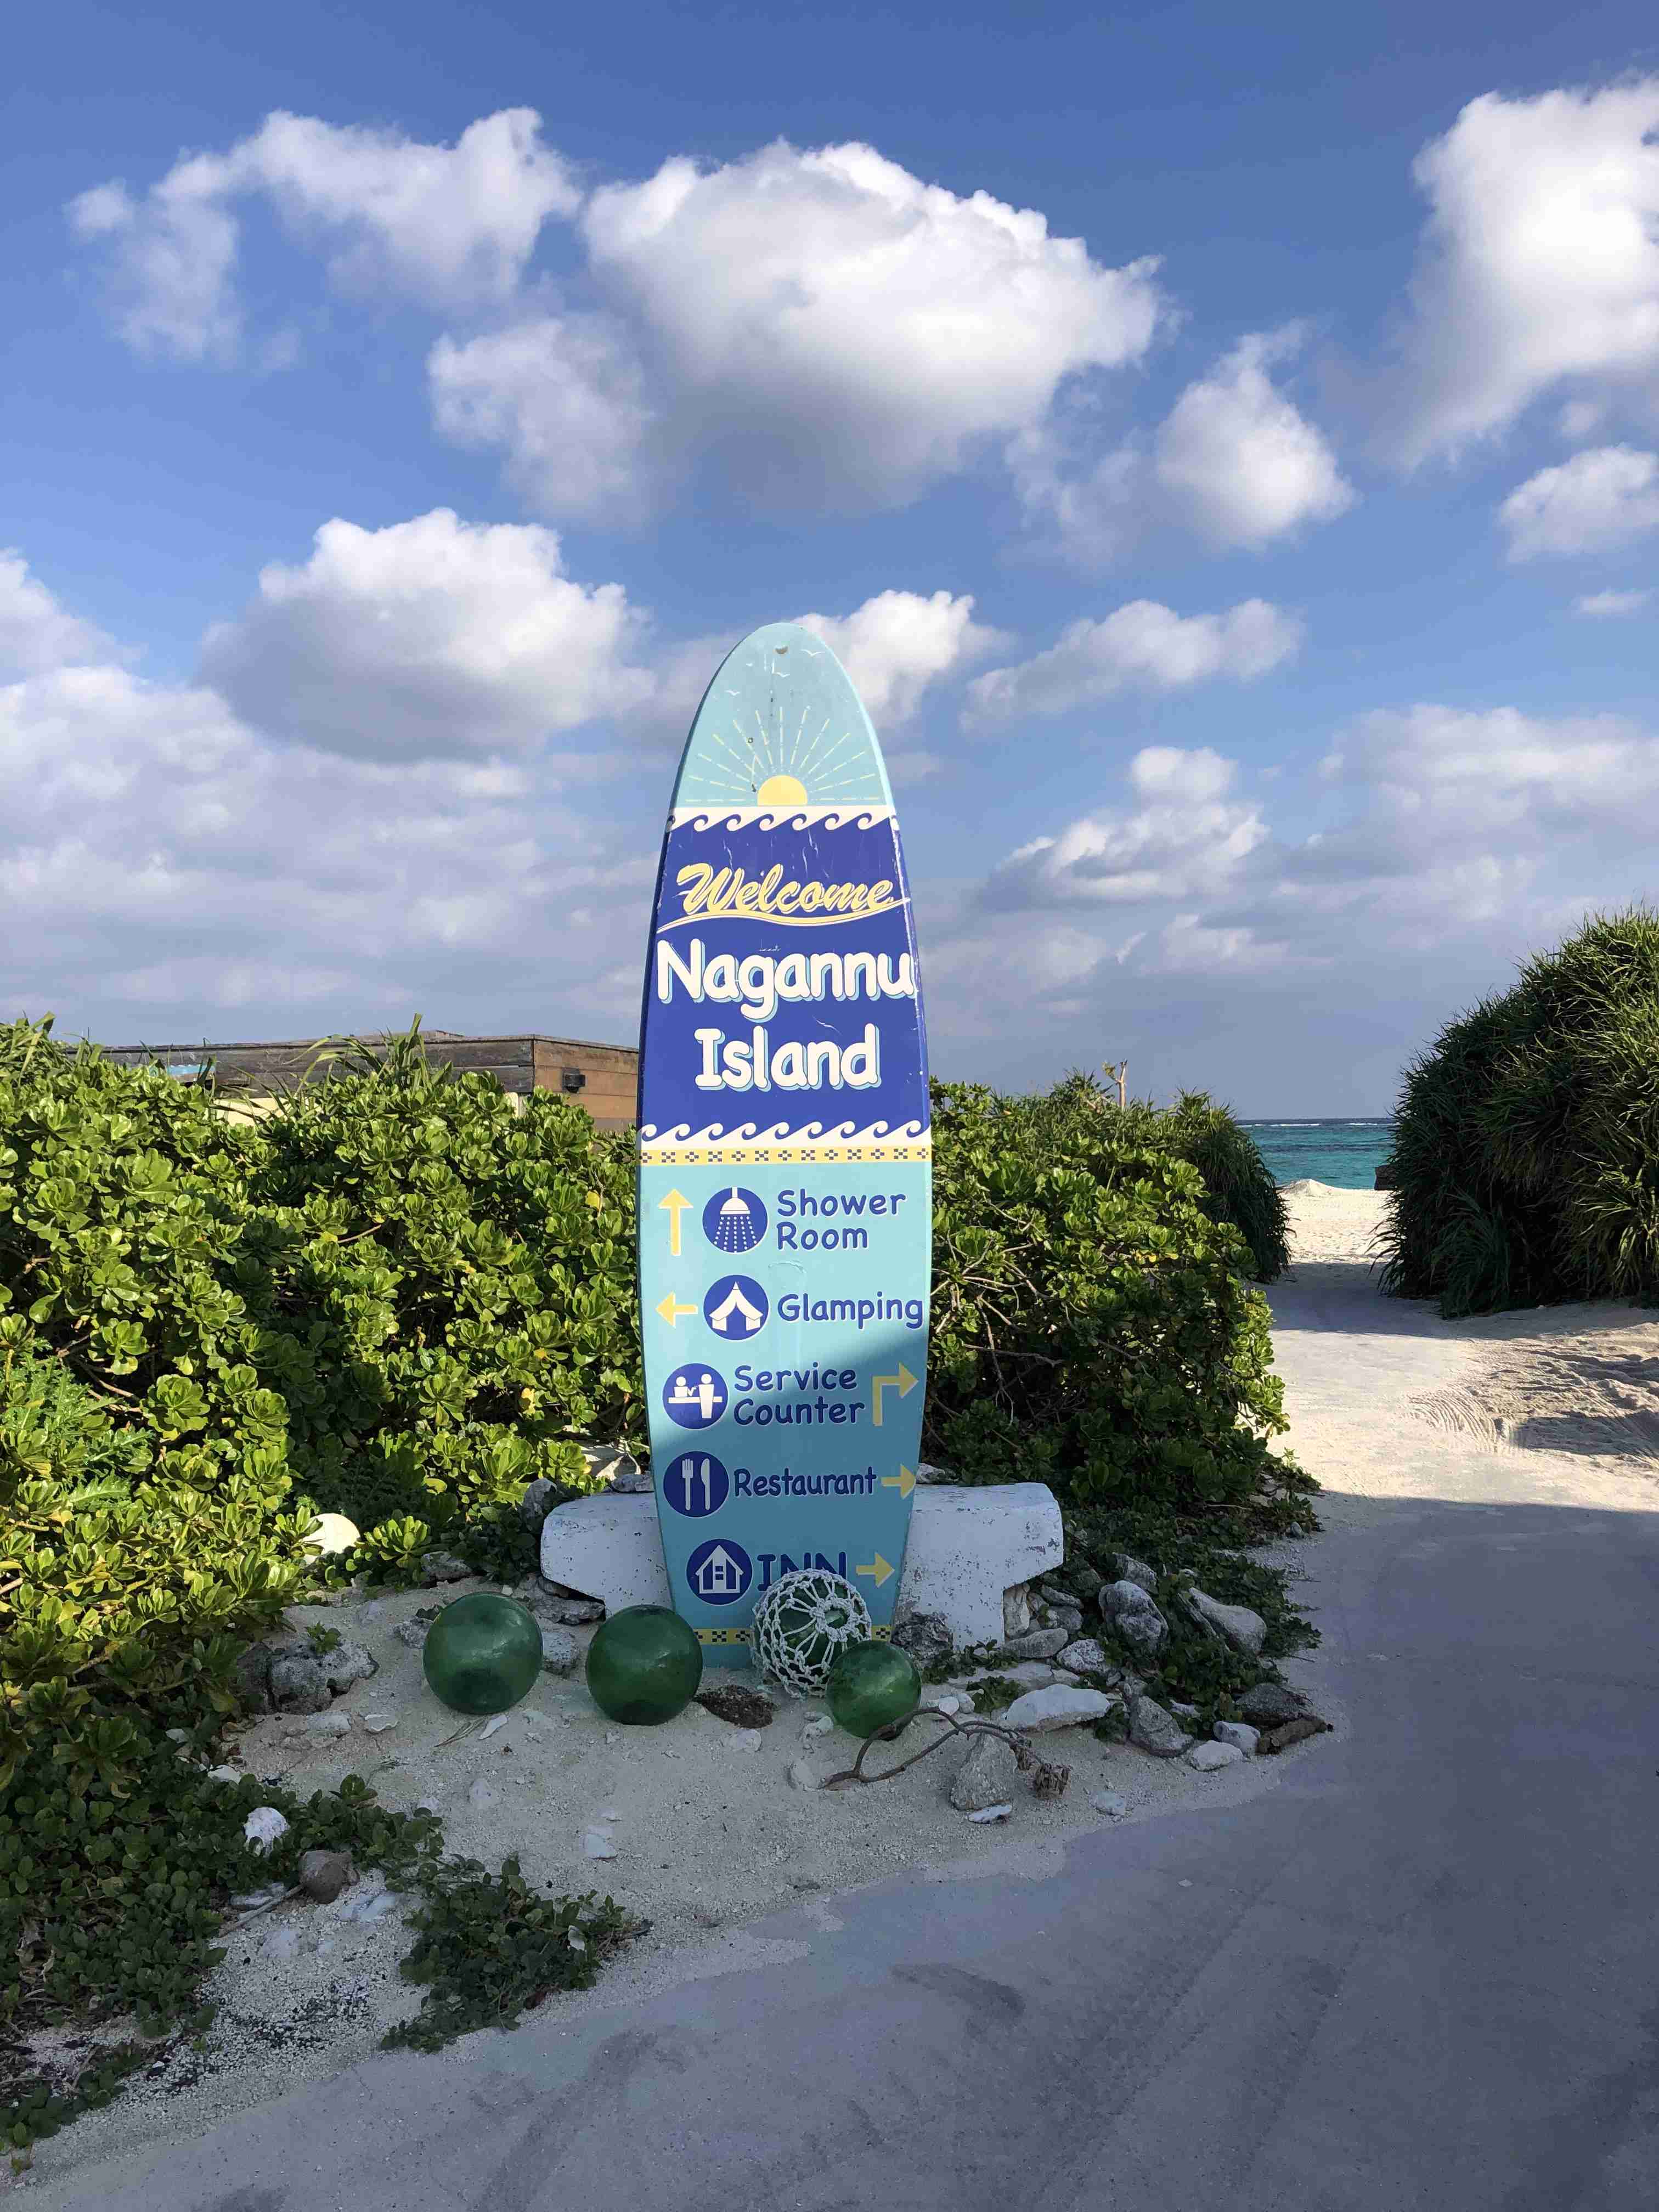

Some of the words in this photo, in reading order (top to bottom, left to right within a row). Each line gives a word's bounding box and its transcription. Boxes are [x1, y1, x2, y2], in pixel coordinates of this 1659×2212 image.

[676, 862, 894, 915] Welcome
[658, 939, 916, 1023] Nagannu
[694, 1023, 881, 1092] Island
[777, 1188, 906, 1217] Shower
[777, 1221, 868, 1250] Room
[777, 1291, 924, 1329] Glamping
[734, 1362, 857, 1391] Service
[733, 1396, 865, 1426] Counter
[733, 1466, 877, 1498] Restaurant
